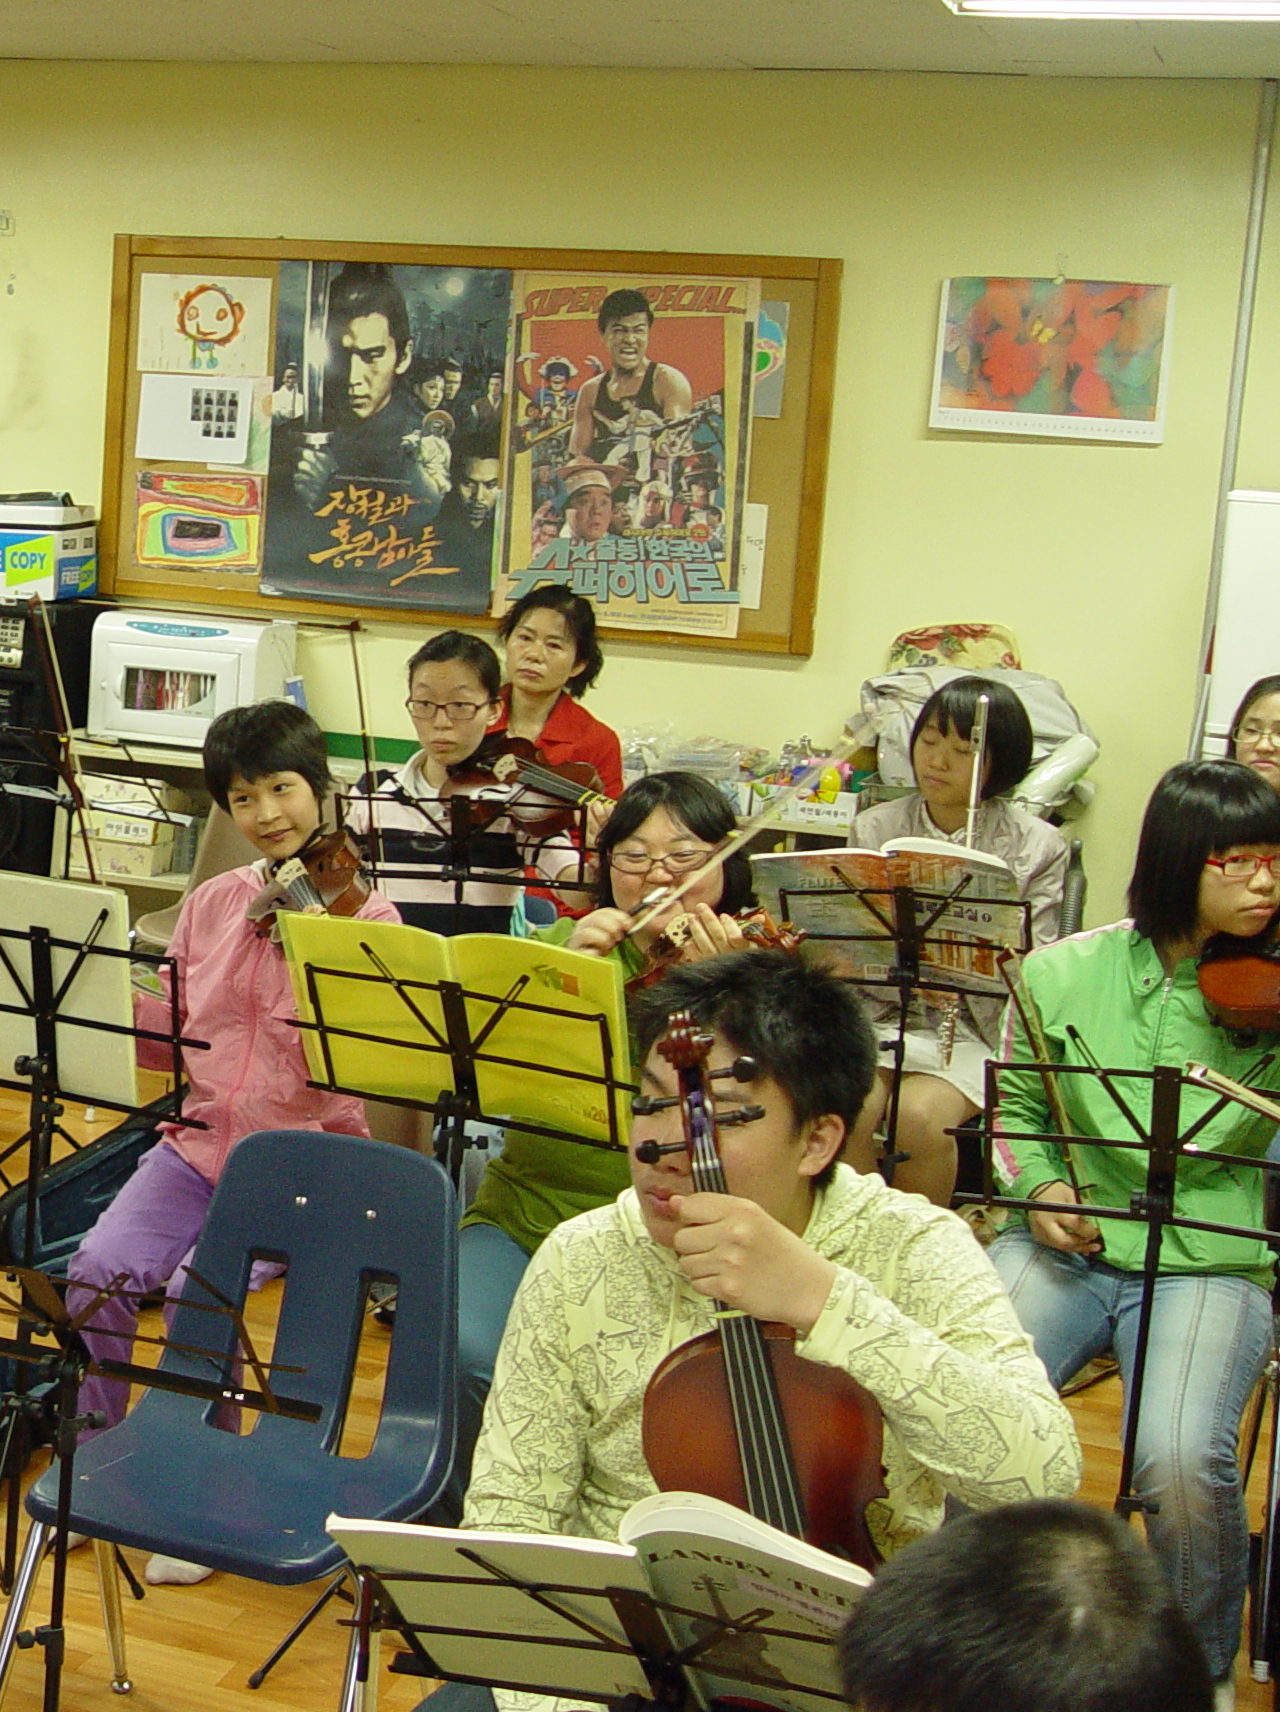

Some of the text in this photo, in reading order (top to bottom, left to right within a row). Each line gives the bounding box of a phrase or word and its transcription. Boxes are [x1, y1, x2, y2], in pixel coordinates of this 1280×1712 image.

[522, 284, 747, 320] SUPER PECIAL...
[9, 551, 47, 570] COPY
[595, 536, 645, 563] 출동!
[646, 537, 714, 564] 한국의
[648, 1549, 774, 1579] LANGEY
[786, 1577, 851, 1607] TUT
